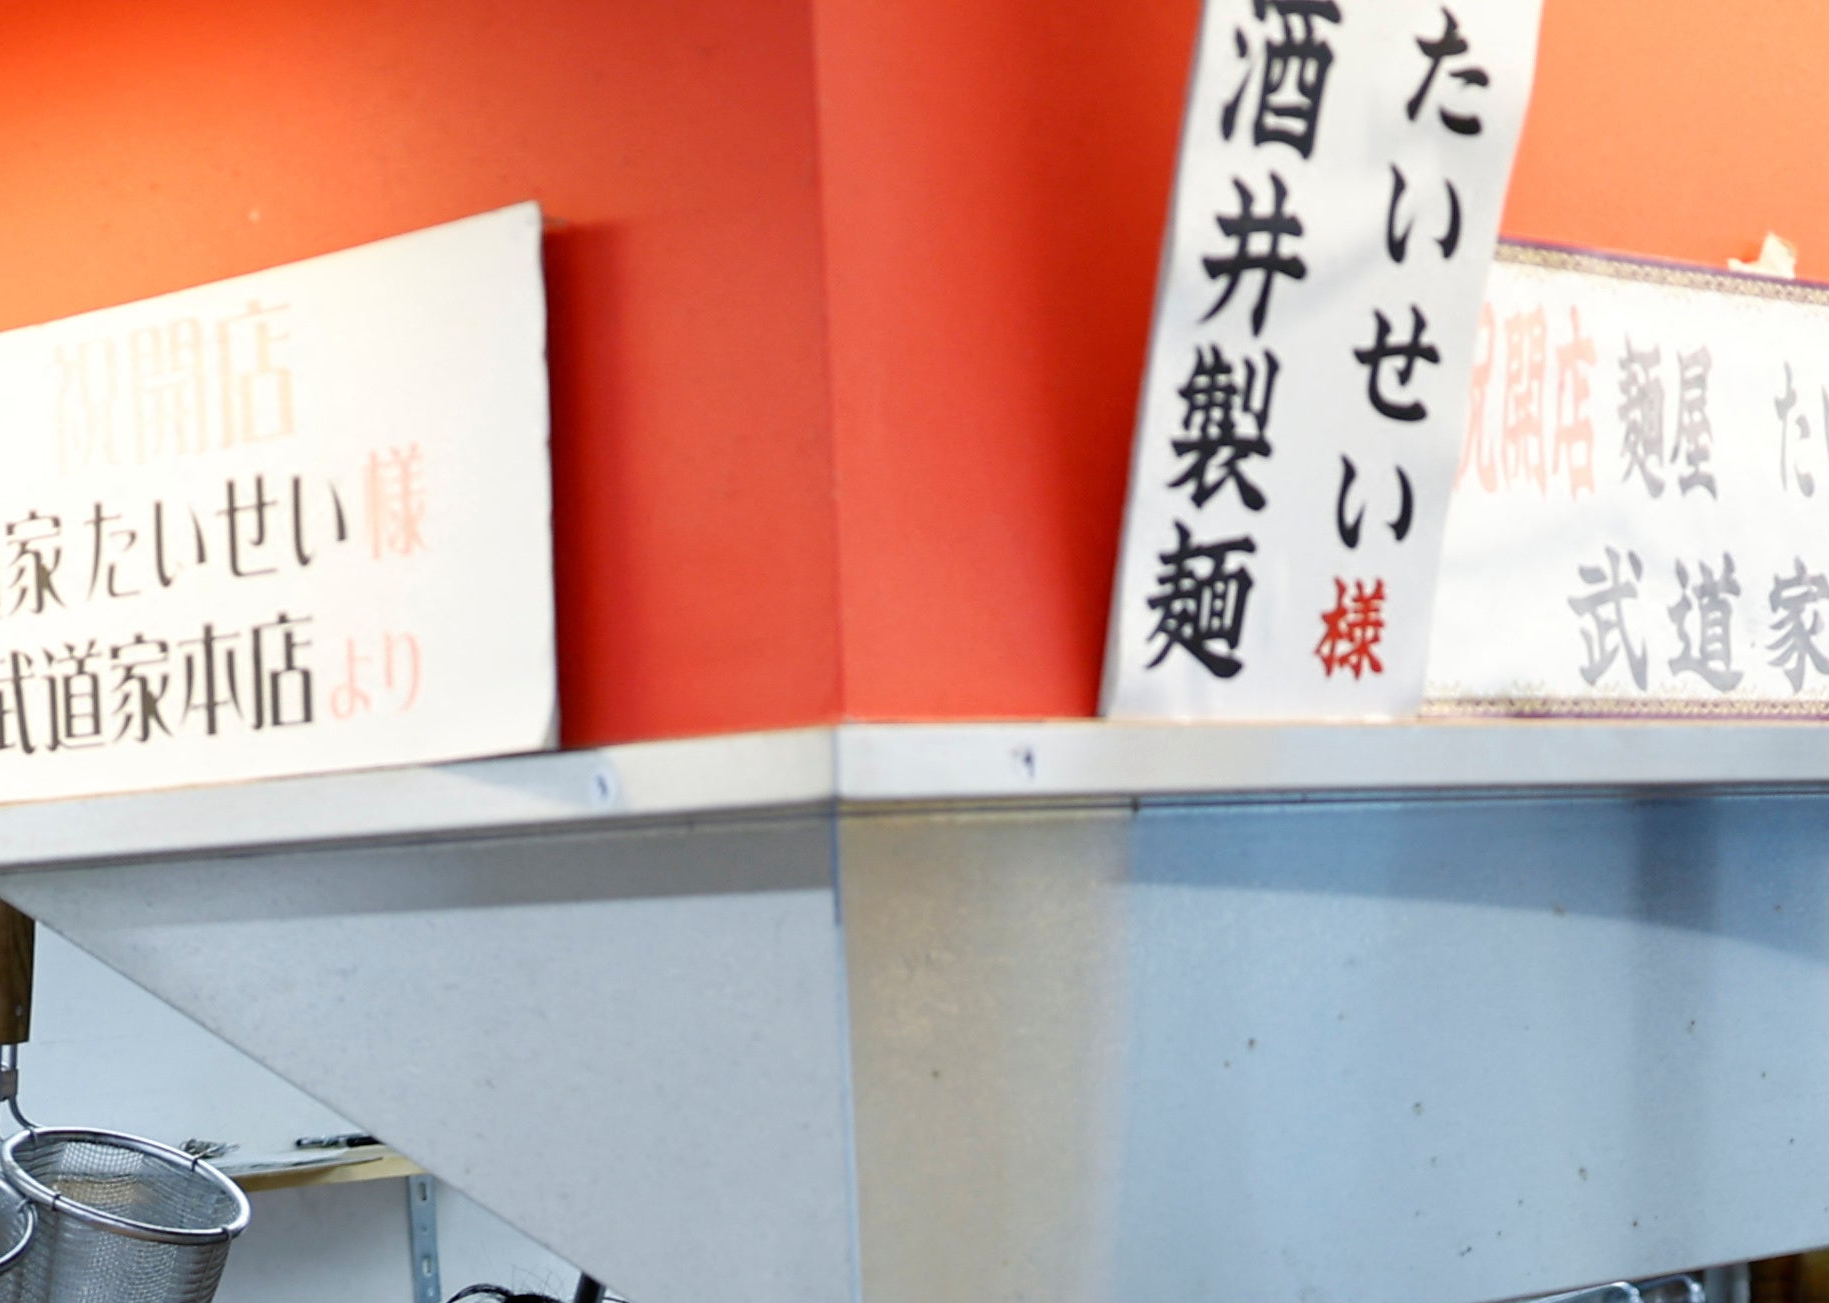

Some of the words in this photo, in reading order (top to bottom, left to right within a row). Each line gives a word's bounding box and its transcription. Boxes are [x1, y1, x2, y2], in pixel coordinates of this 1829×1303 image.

[1143, 0, 1345, 681] 酒井製麺
[1313, 6, 1492, 683] たいせい様
